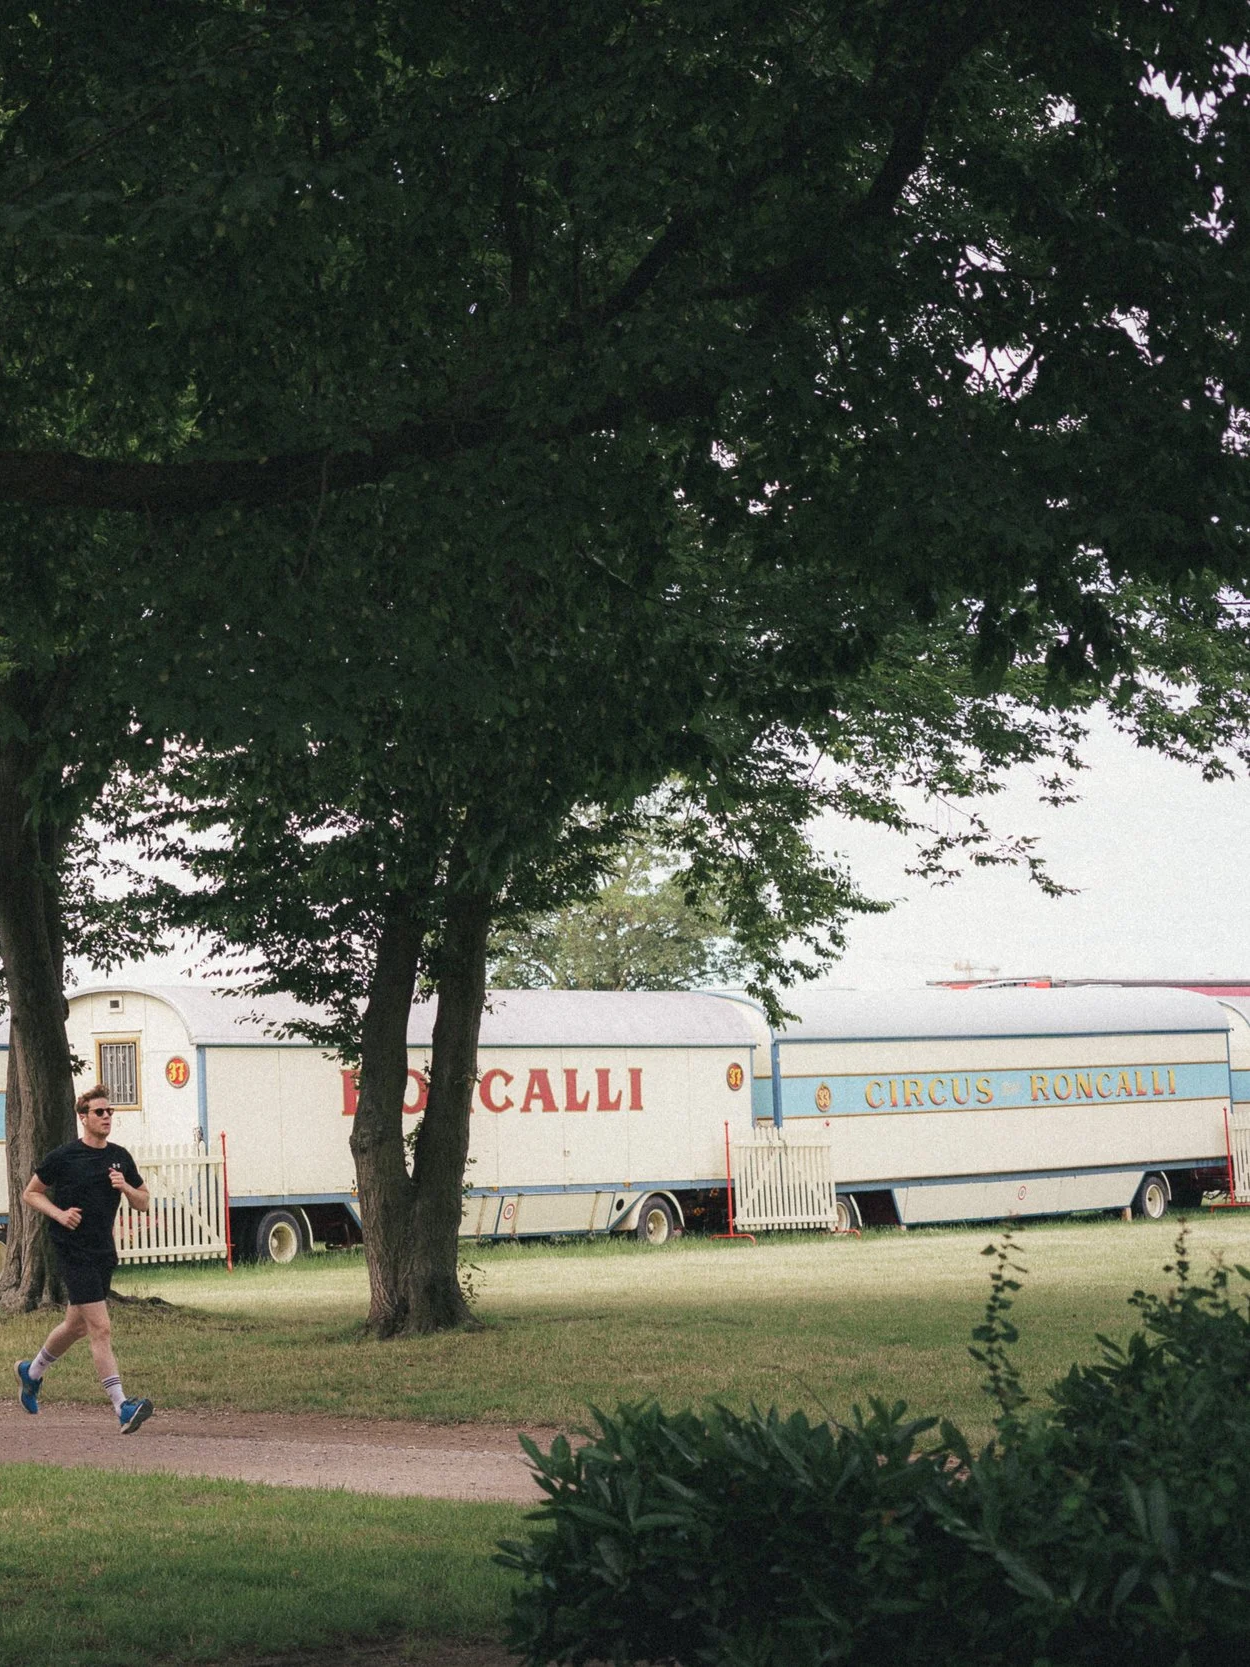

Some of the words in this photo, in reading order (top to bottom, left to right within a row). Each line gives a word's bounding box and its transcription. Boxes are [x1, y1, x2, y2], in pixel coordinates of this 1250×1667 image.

[169, 1062, 185, 1082] 37
[729, 1067, 742, 1086] 37
[865, 1076, 994, 1109] CIRCUS
[1030, 1068, 1176, 1101] RONCALLI
